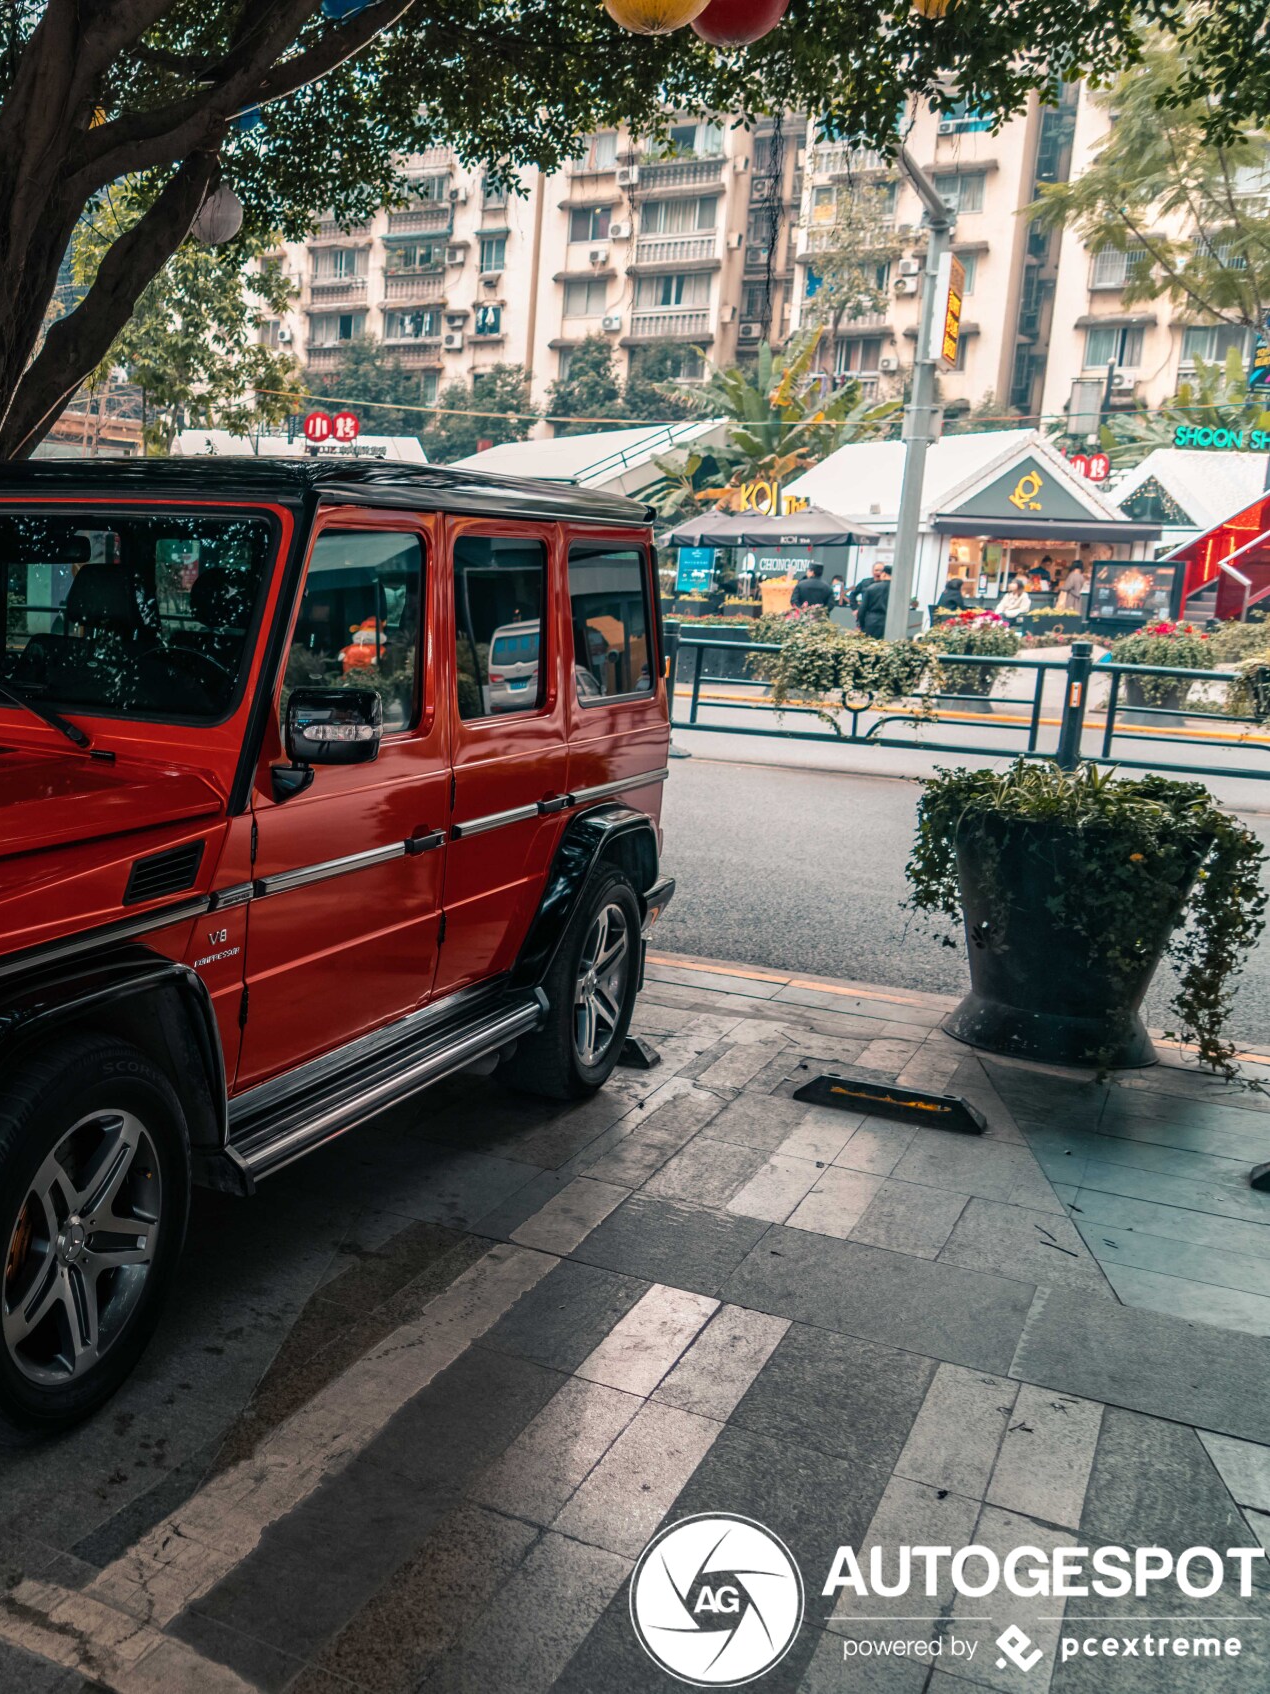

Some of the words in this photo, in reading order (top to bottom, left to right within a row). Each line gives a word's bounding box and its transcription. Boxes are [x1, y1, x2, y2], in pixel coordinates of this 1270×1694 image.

[1175, 426, 1244, 449] SHOON
[740, 482, 778, 516] KOI
[1008, 470, 1043, 510] KOI
[759, 557, 813, 572] CHONGQIN
[208, 928, 227, 946] V8
